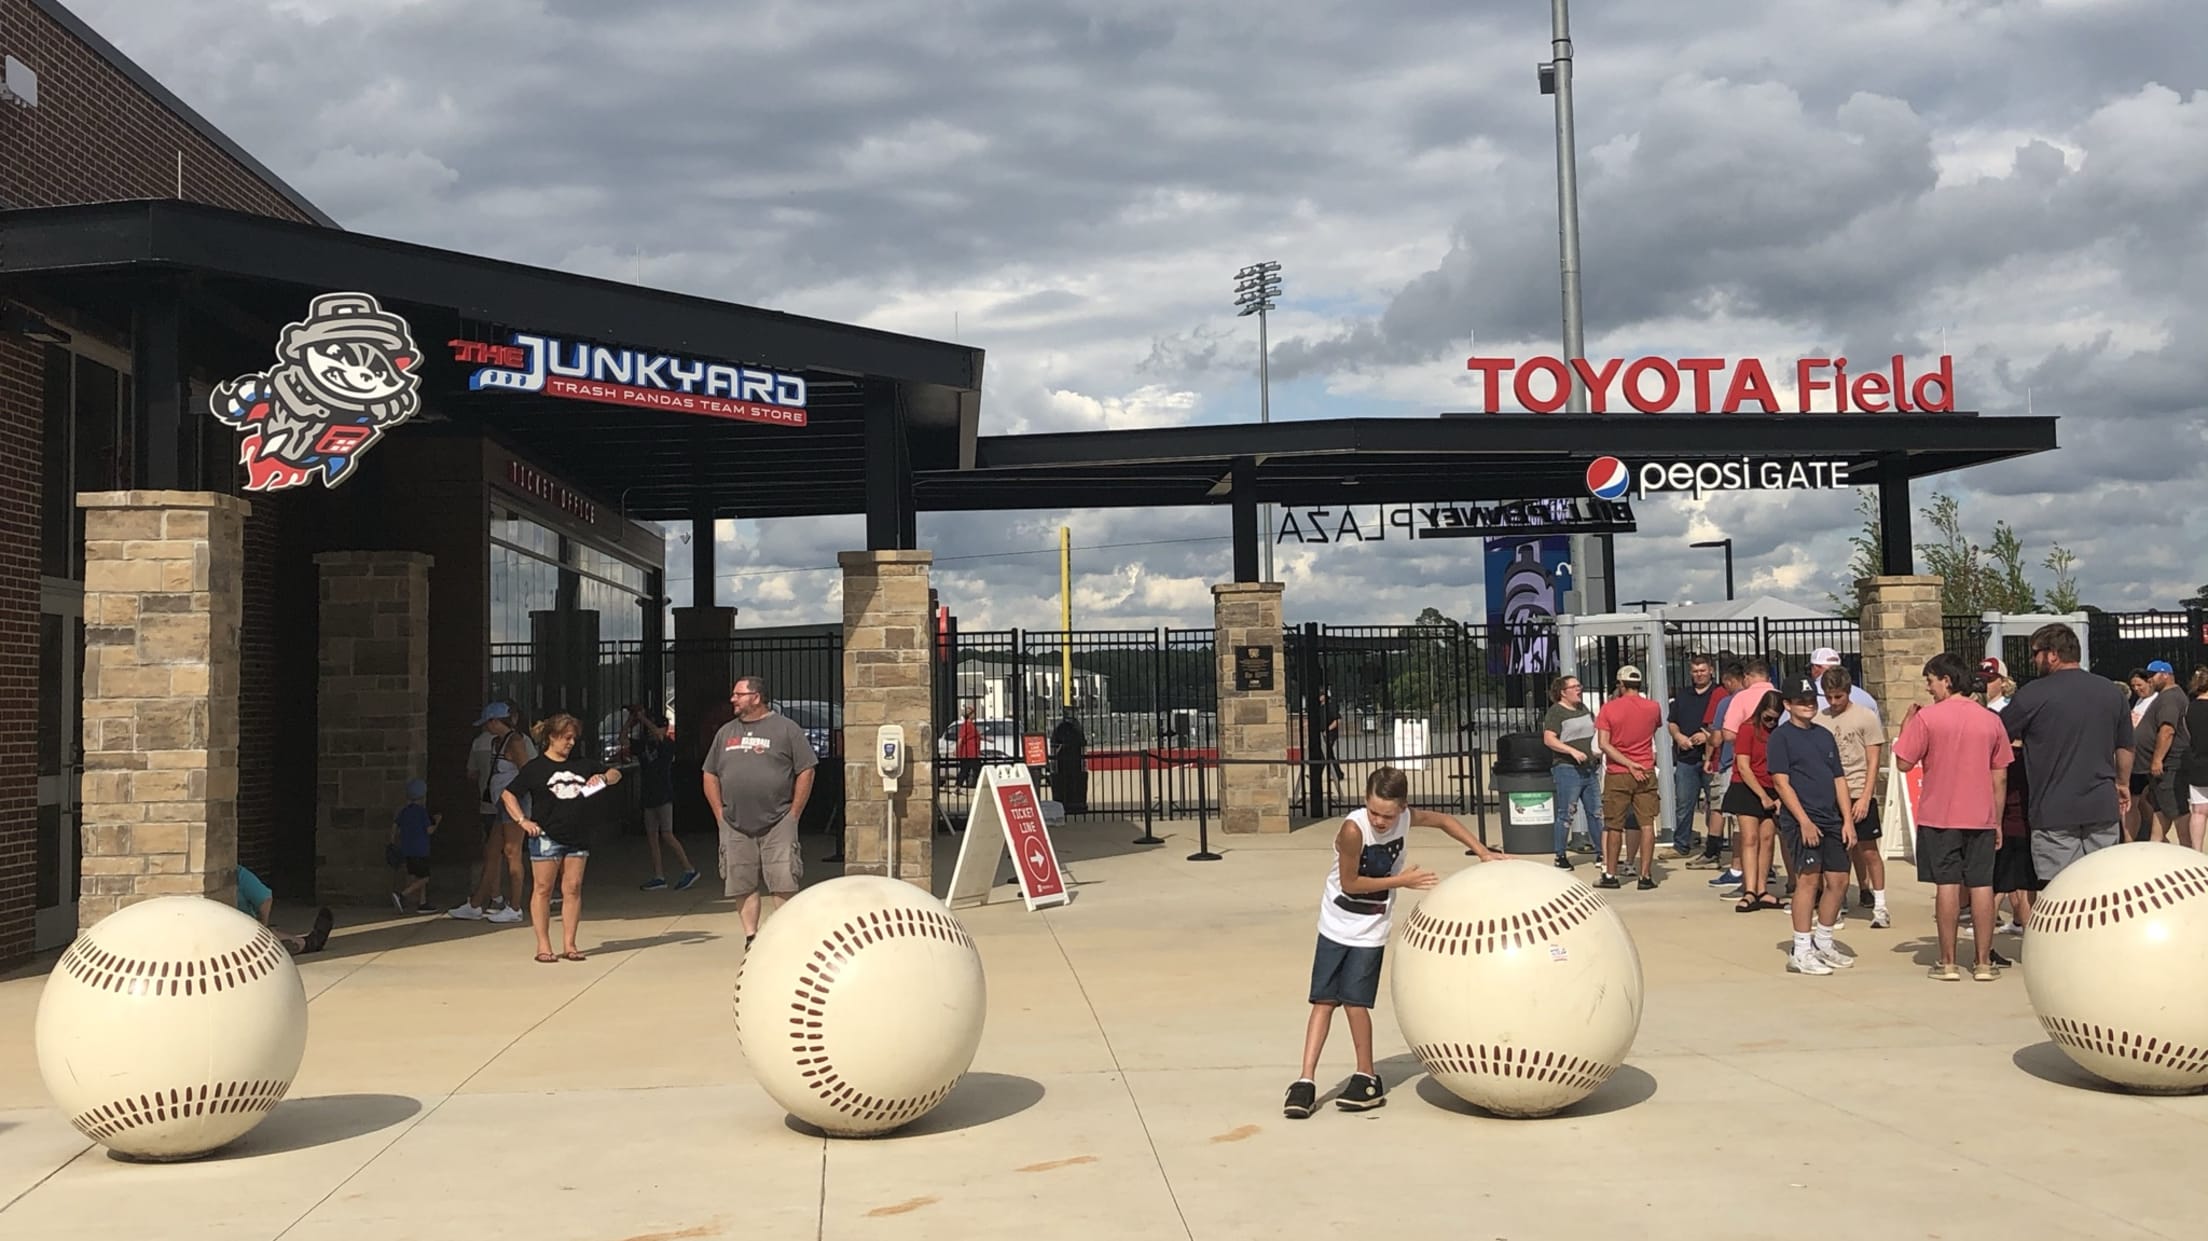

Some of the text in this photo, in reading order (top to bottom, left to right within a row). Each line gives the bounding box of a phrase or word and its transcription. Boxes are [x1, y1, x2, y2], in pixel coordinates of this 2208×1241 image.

[447, 332, 807, 409] THE JUNKYARD
[1466, 354, 1955, 414] TOYOTA Field
[552, 381, 804, 423] TRASH PANDAS TEAM STORE
[511, 461, 595, 525] TICKET OFFICE
[1639, 456, 1850, 501] pepsi GATE
[1801, 679, 1814, 692] A
[1010, 807, 1035, 820] TICKET
[1019, 821, 1038, 834] LINE
